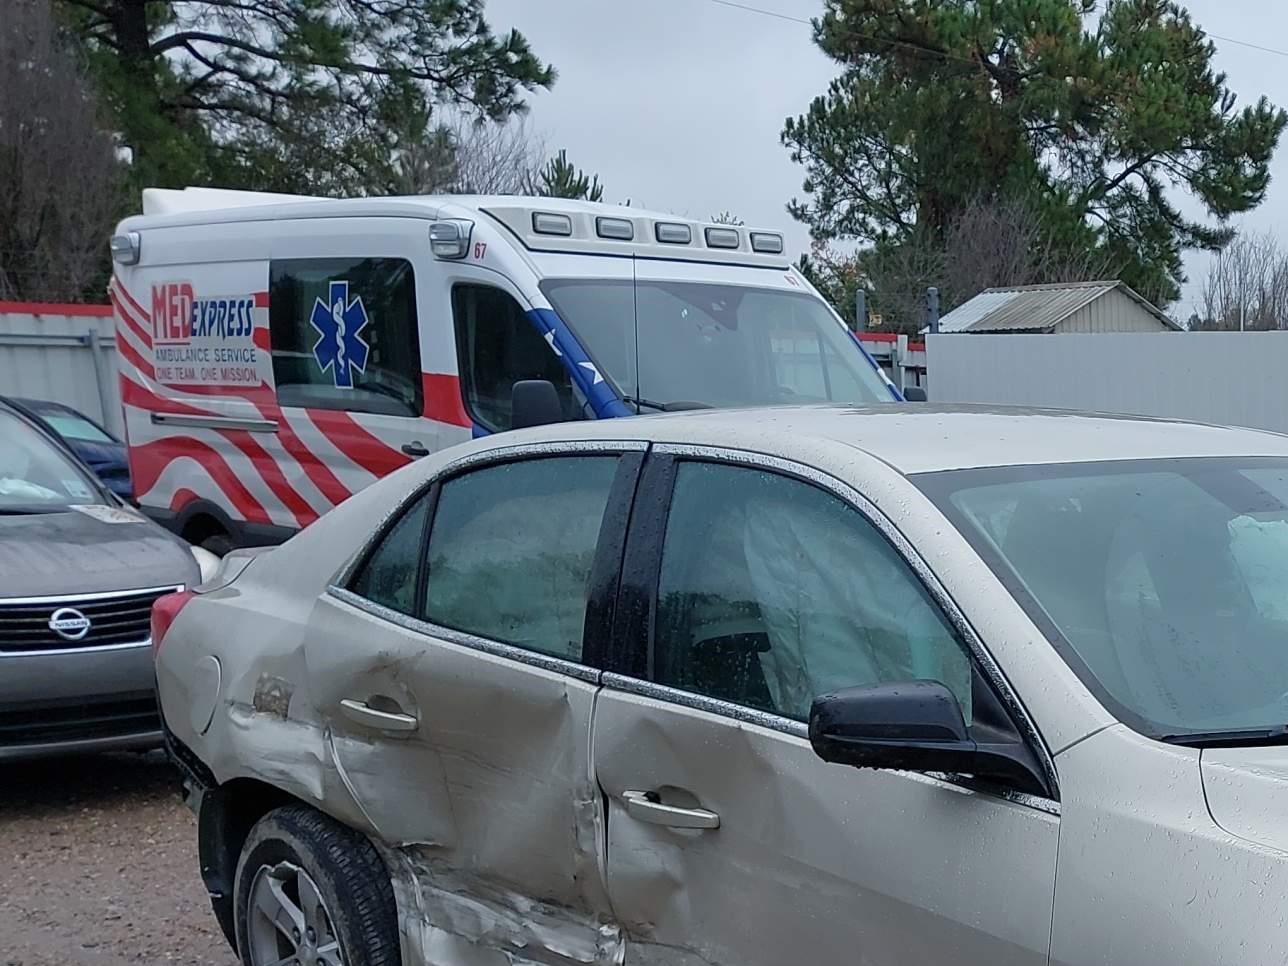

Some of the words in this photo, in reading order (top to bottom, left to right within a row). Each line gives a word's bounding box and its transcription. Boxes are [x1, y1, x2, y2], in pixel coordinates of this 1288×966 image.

[474, 242, 487, 259] 67
[156, 347, 209, 363] AMBULANCE
[214, 348, 257, 363] SERVICE
[157, 367, 173, 380] ONE
[200, 367, 217, 381] ONE
[55, 620, 88, 628] NISSAN
